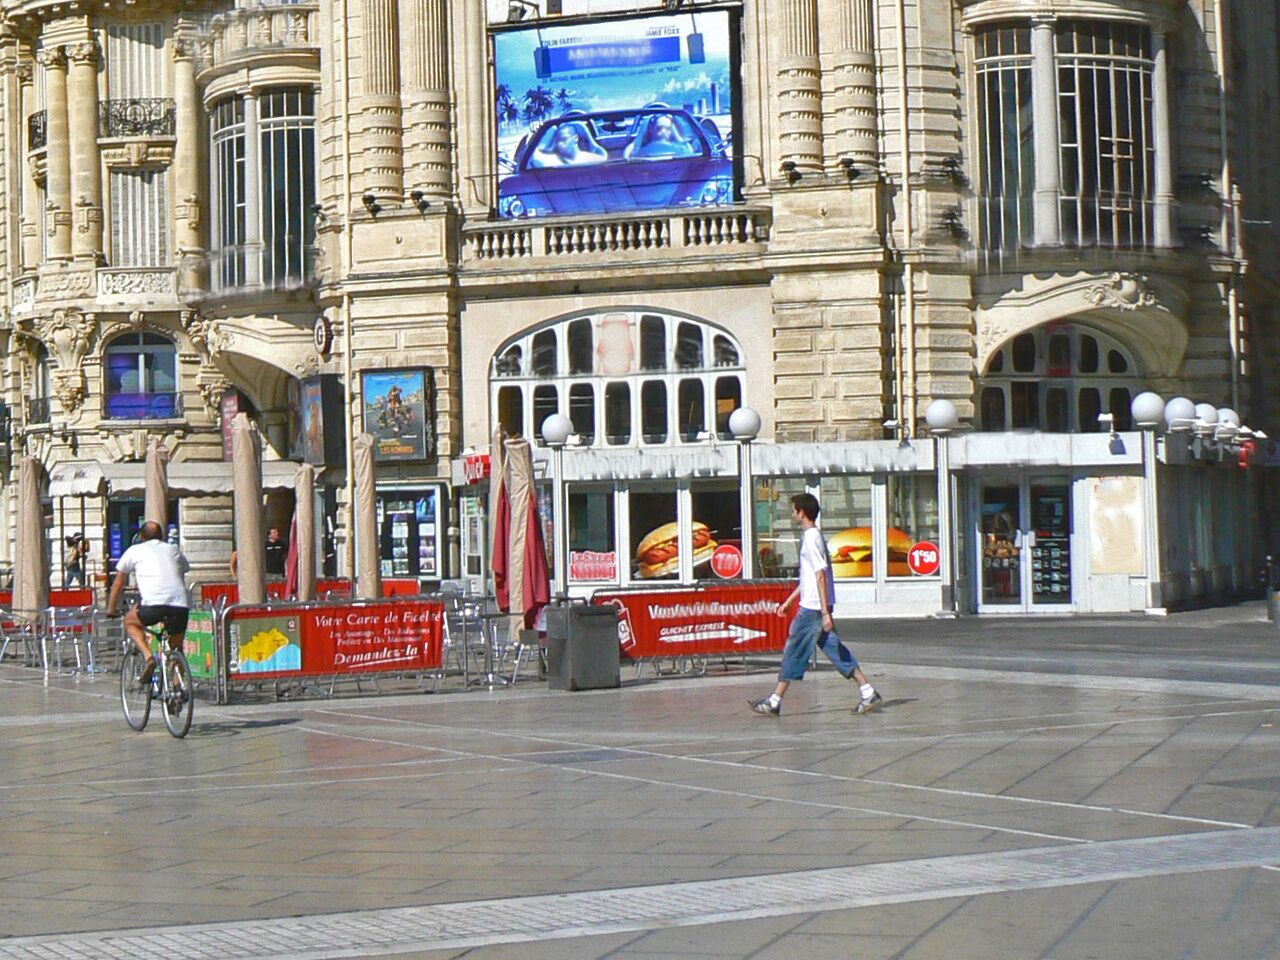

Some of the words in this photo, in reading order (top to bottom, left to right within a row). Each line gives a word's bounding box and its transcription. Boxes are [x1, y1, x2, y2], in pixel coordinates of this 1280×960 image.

[316, 325, 324, 345] G
[314, 615, 343, 628] Votre
[347, 614, 380, 626] Carte
[384, 611, 398, 624] de
[334, 644, 418, 665] Demandez-la
